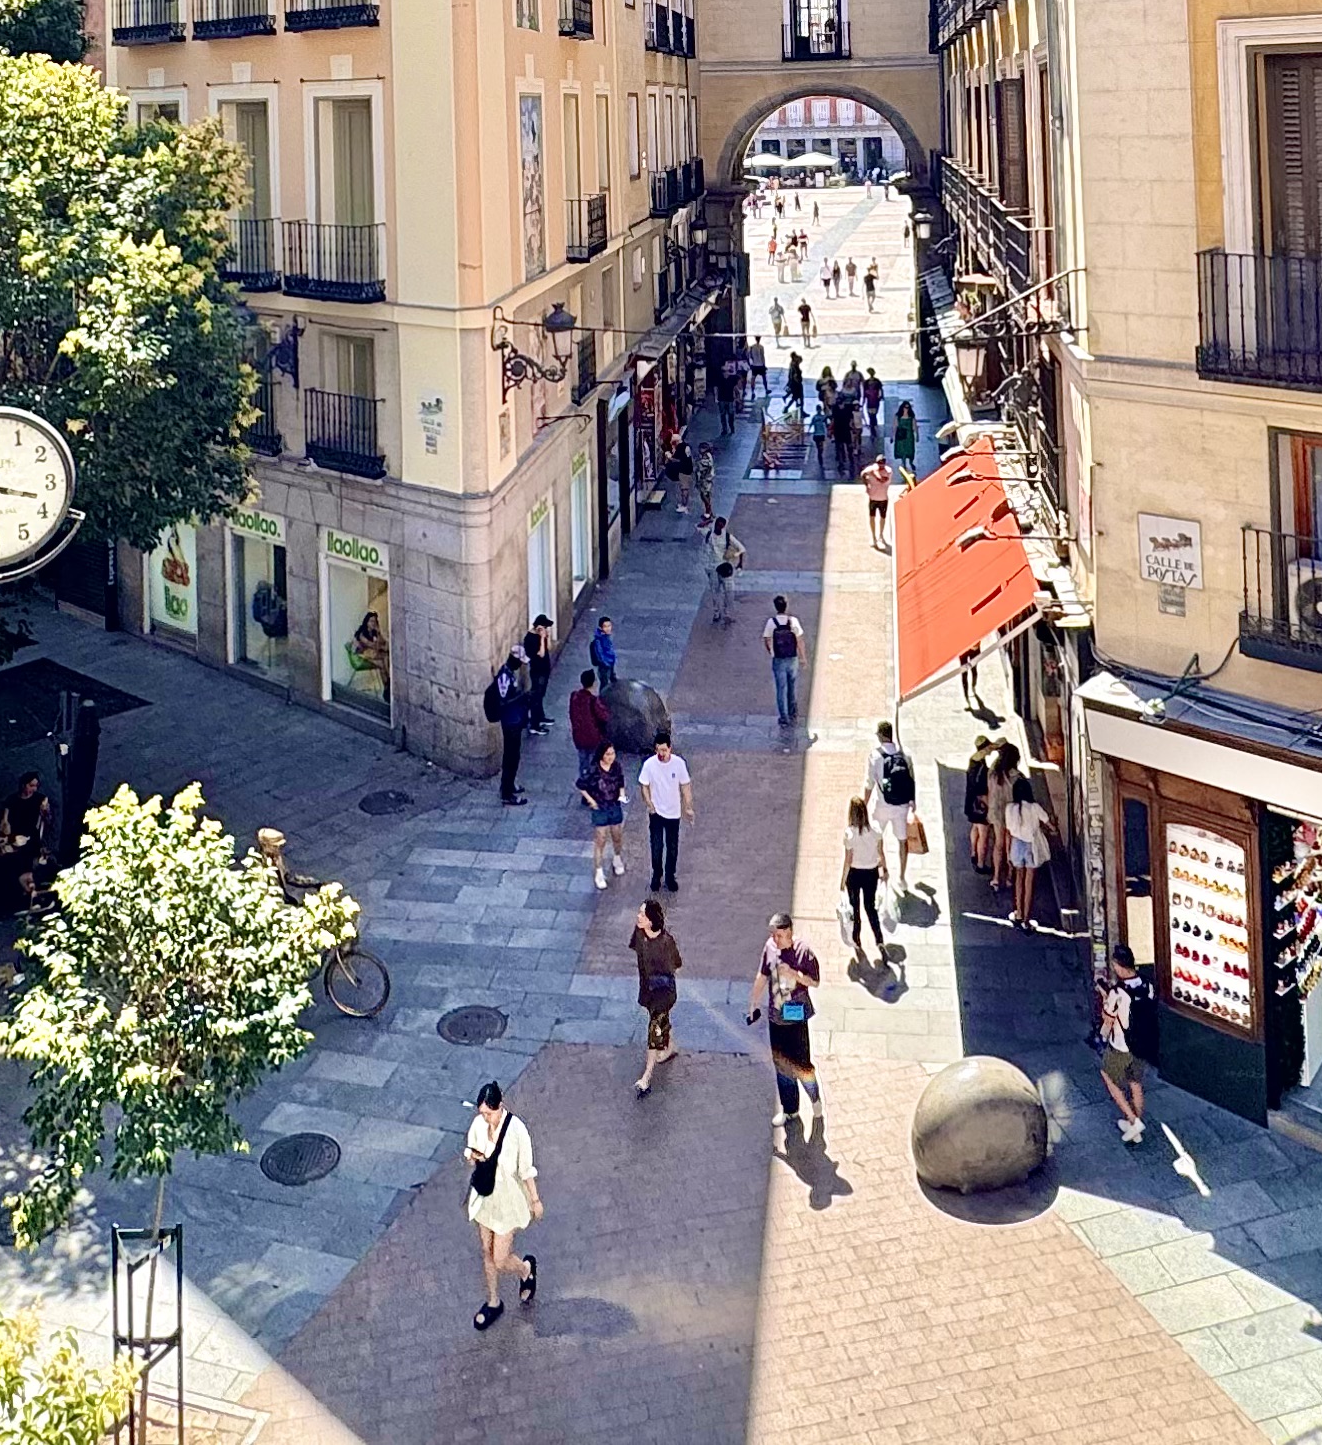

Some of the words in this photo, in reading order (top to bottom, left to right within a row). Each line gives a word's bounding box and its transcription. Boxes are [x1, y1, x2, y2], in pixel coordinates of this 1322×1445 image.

[14, 430, 22, 446] 1
[34, 446, 47, 463] 2
[45, 473, 57, 491] 3
[37, 502, 48, 519] 4
[18, 523, 29, 541] 5
[1145, 554, 1181, 570] CALLE
[1184, 561, 1195, 571] DE
[1147, 565, 1198, 586] POSTAS
